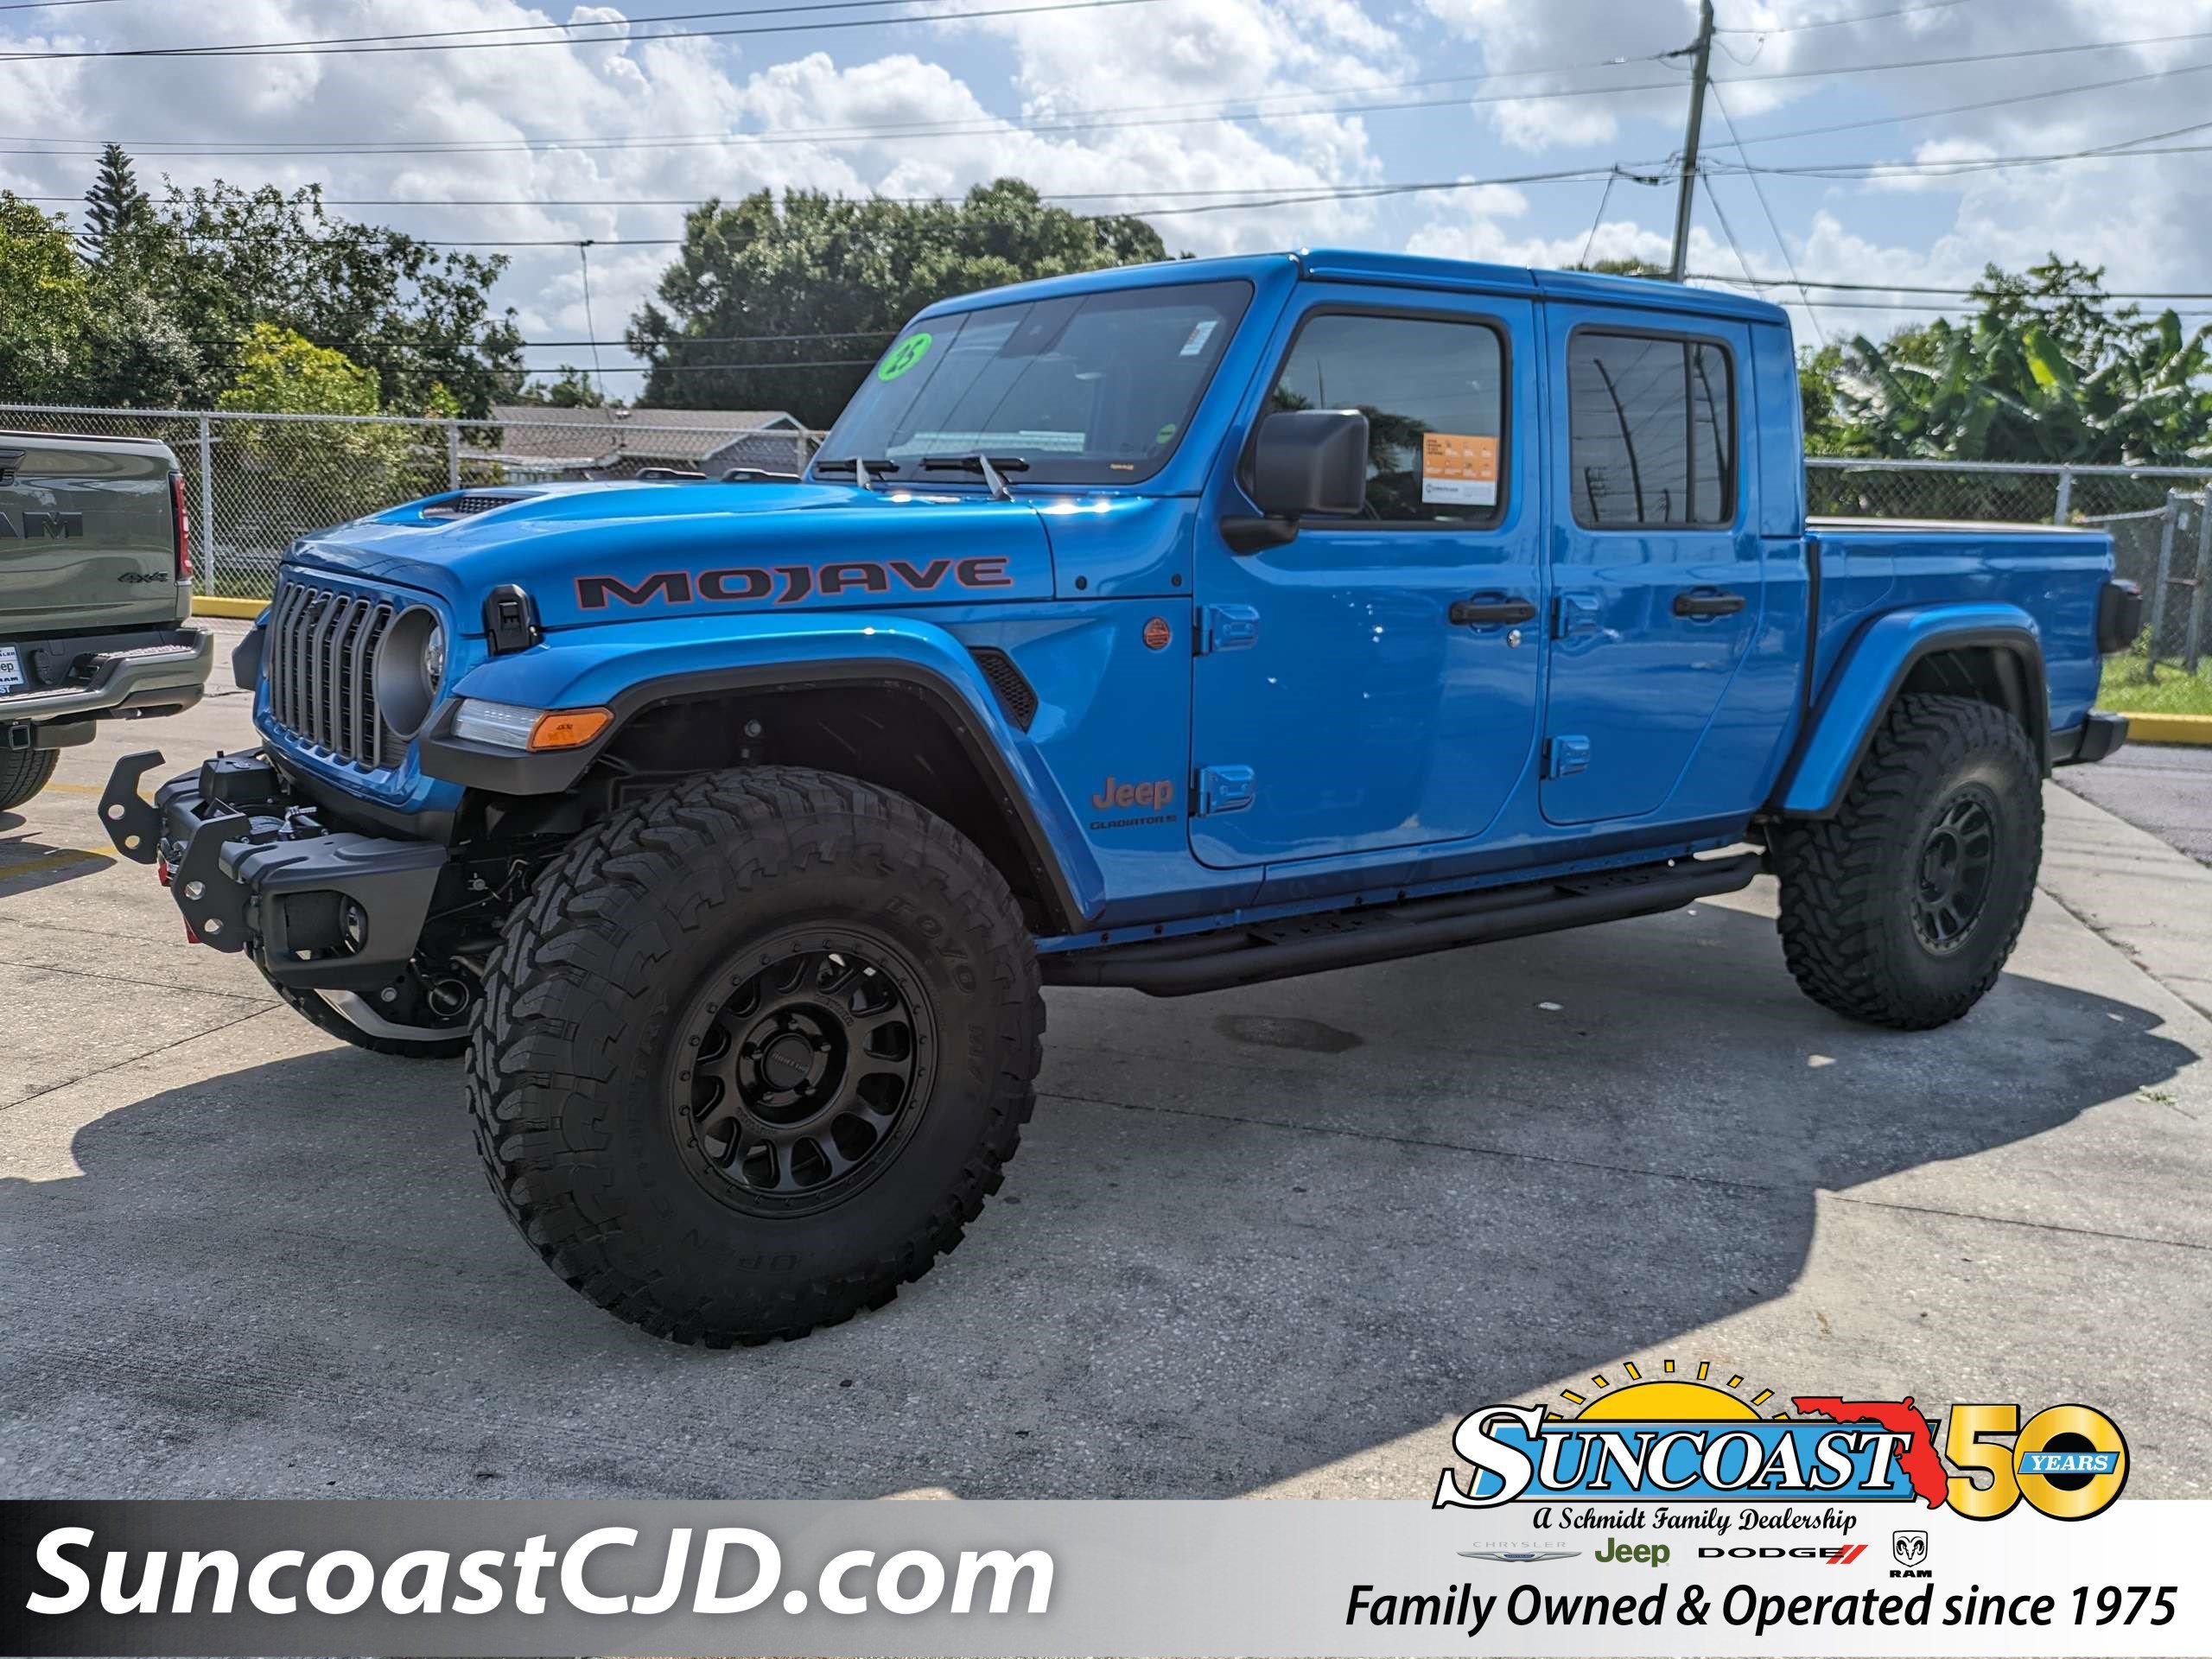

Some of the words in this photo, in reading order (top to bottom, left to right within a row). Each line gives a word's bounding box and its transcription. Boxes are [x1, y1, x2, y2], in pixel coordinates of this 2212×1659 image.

[574, 556, 1013, 609] MOJAVE
[0, 663, 14, 672] ep
[1092, 777, 1173, 810] Jeep
[886, 894, 976, 994] TOYO
